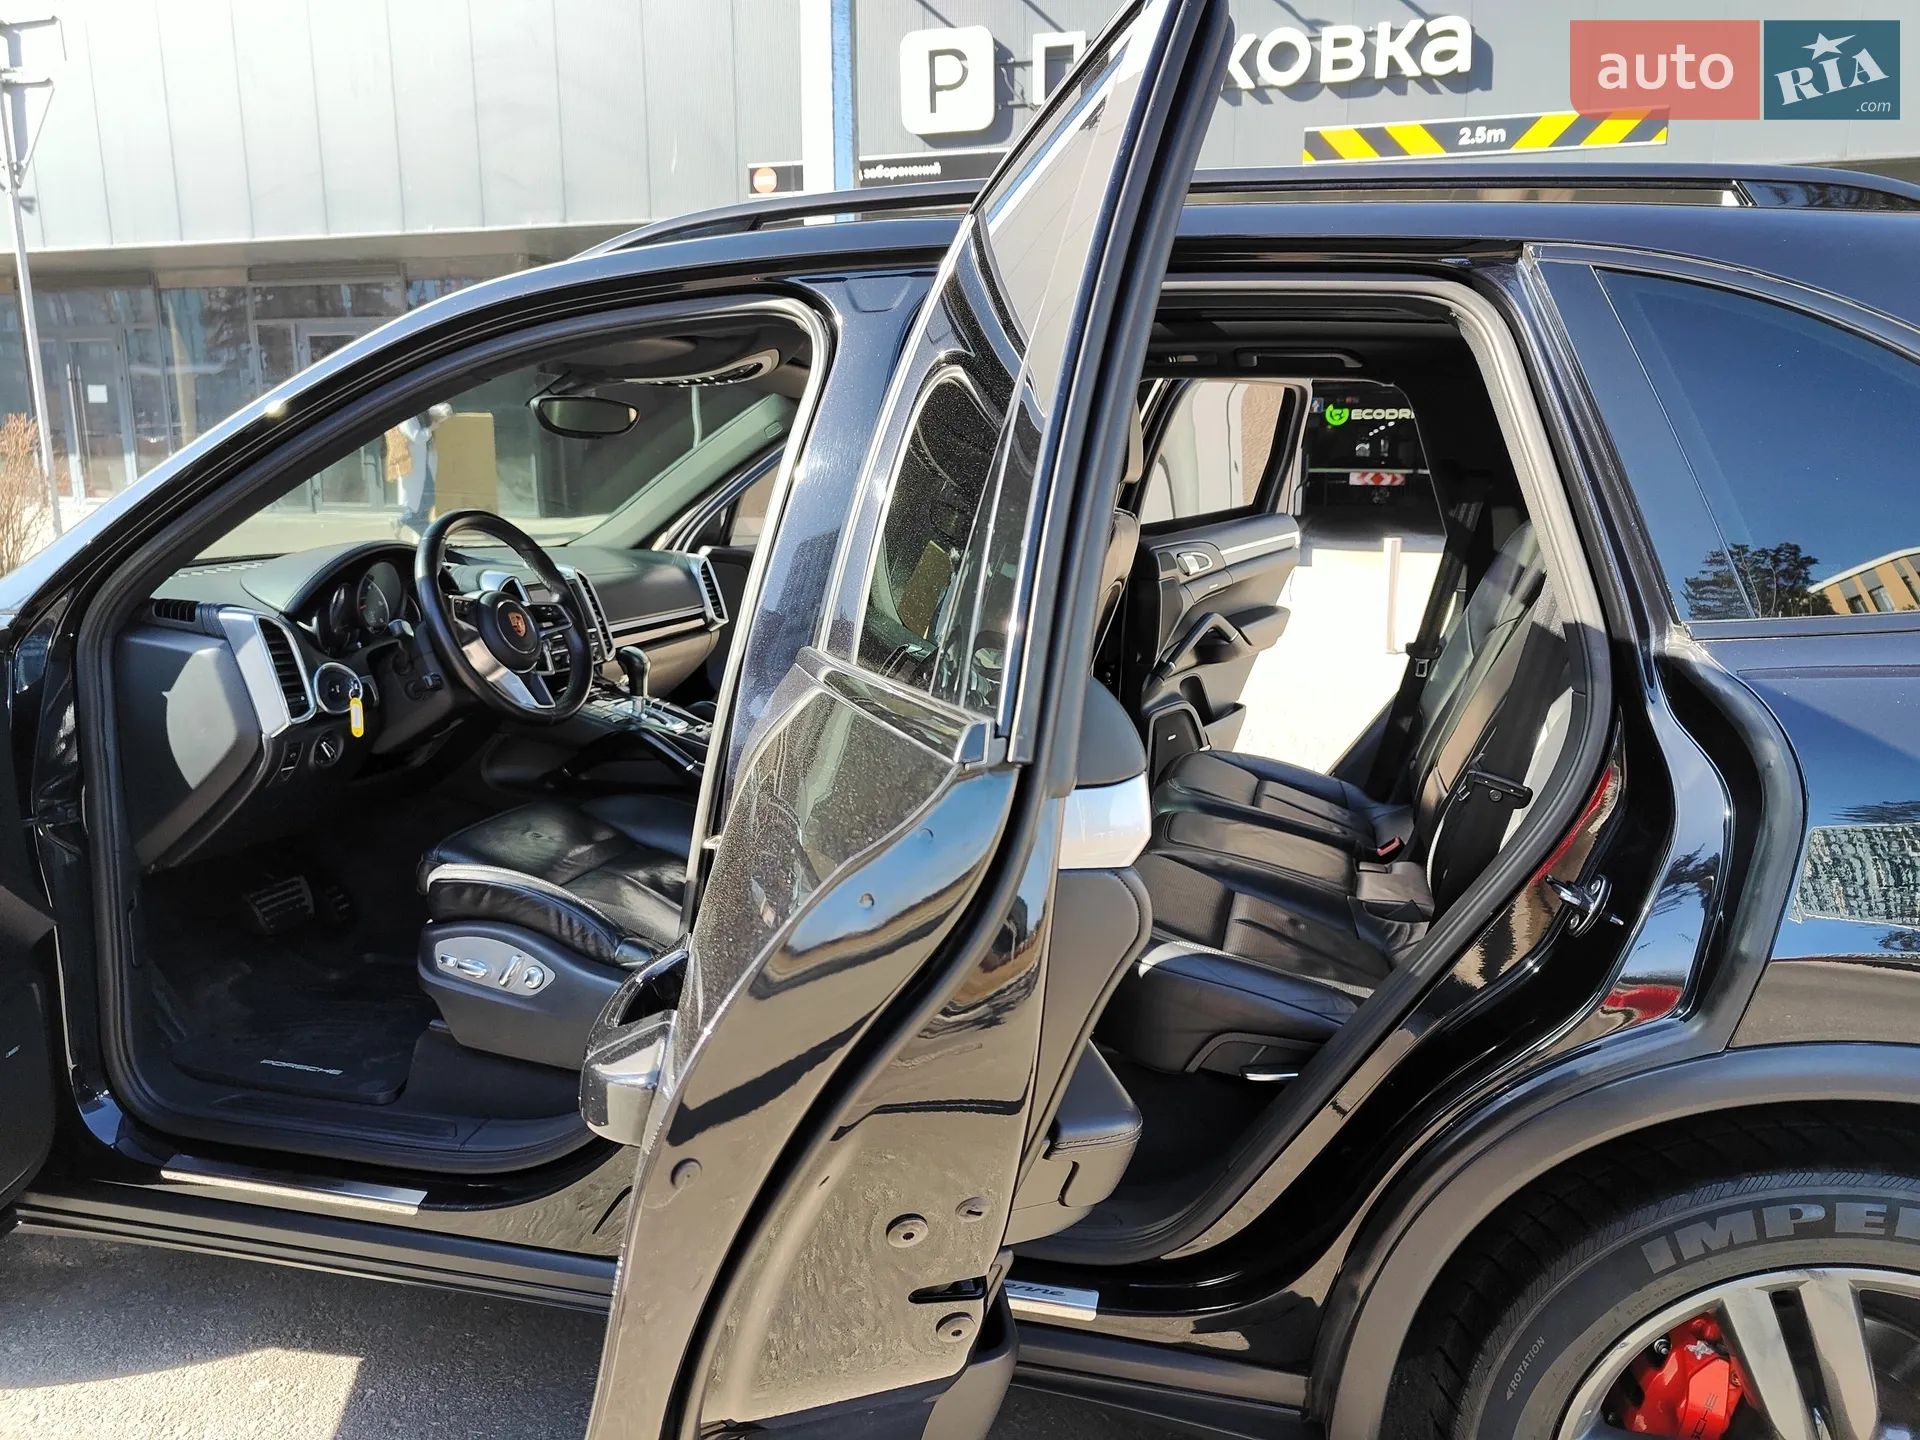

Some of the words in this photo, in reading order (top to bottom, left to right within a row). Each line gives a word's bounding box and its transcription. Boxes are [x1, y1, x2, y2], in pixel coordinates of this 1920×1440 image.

[1033, 16, 1472, 105] Пковка
[1004, 1283, 1066, 1297] enne
[1509, 1336, 1546, 1392] ROTATION
